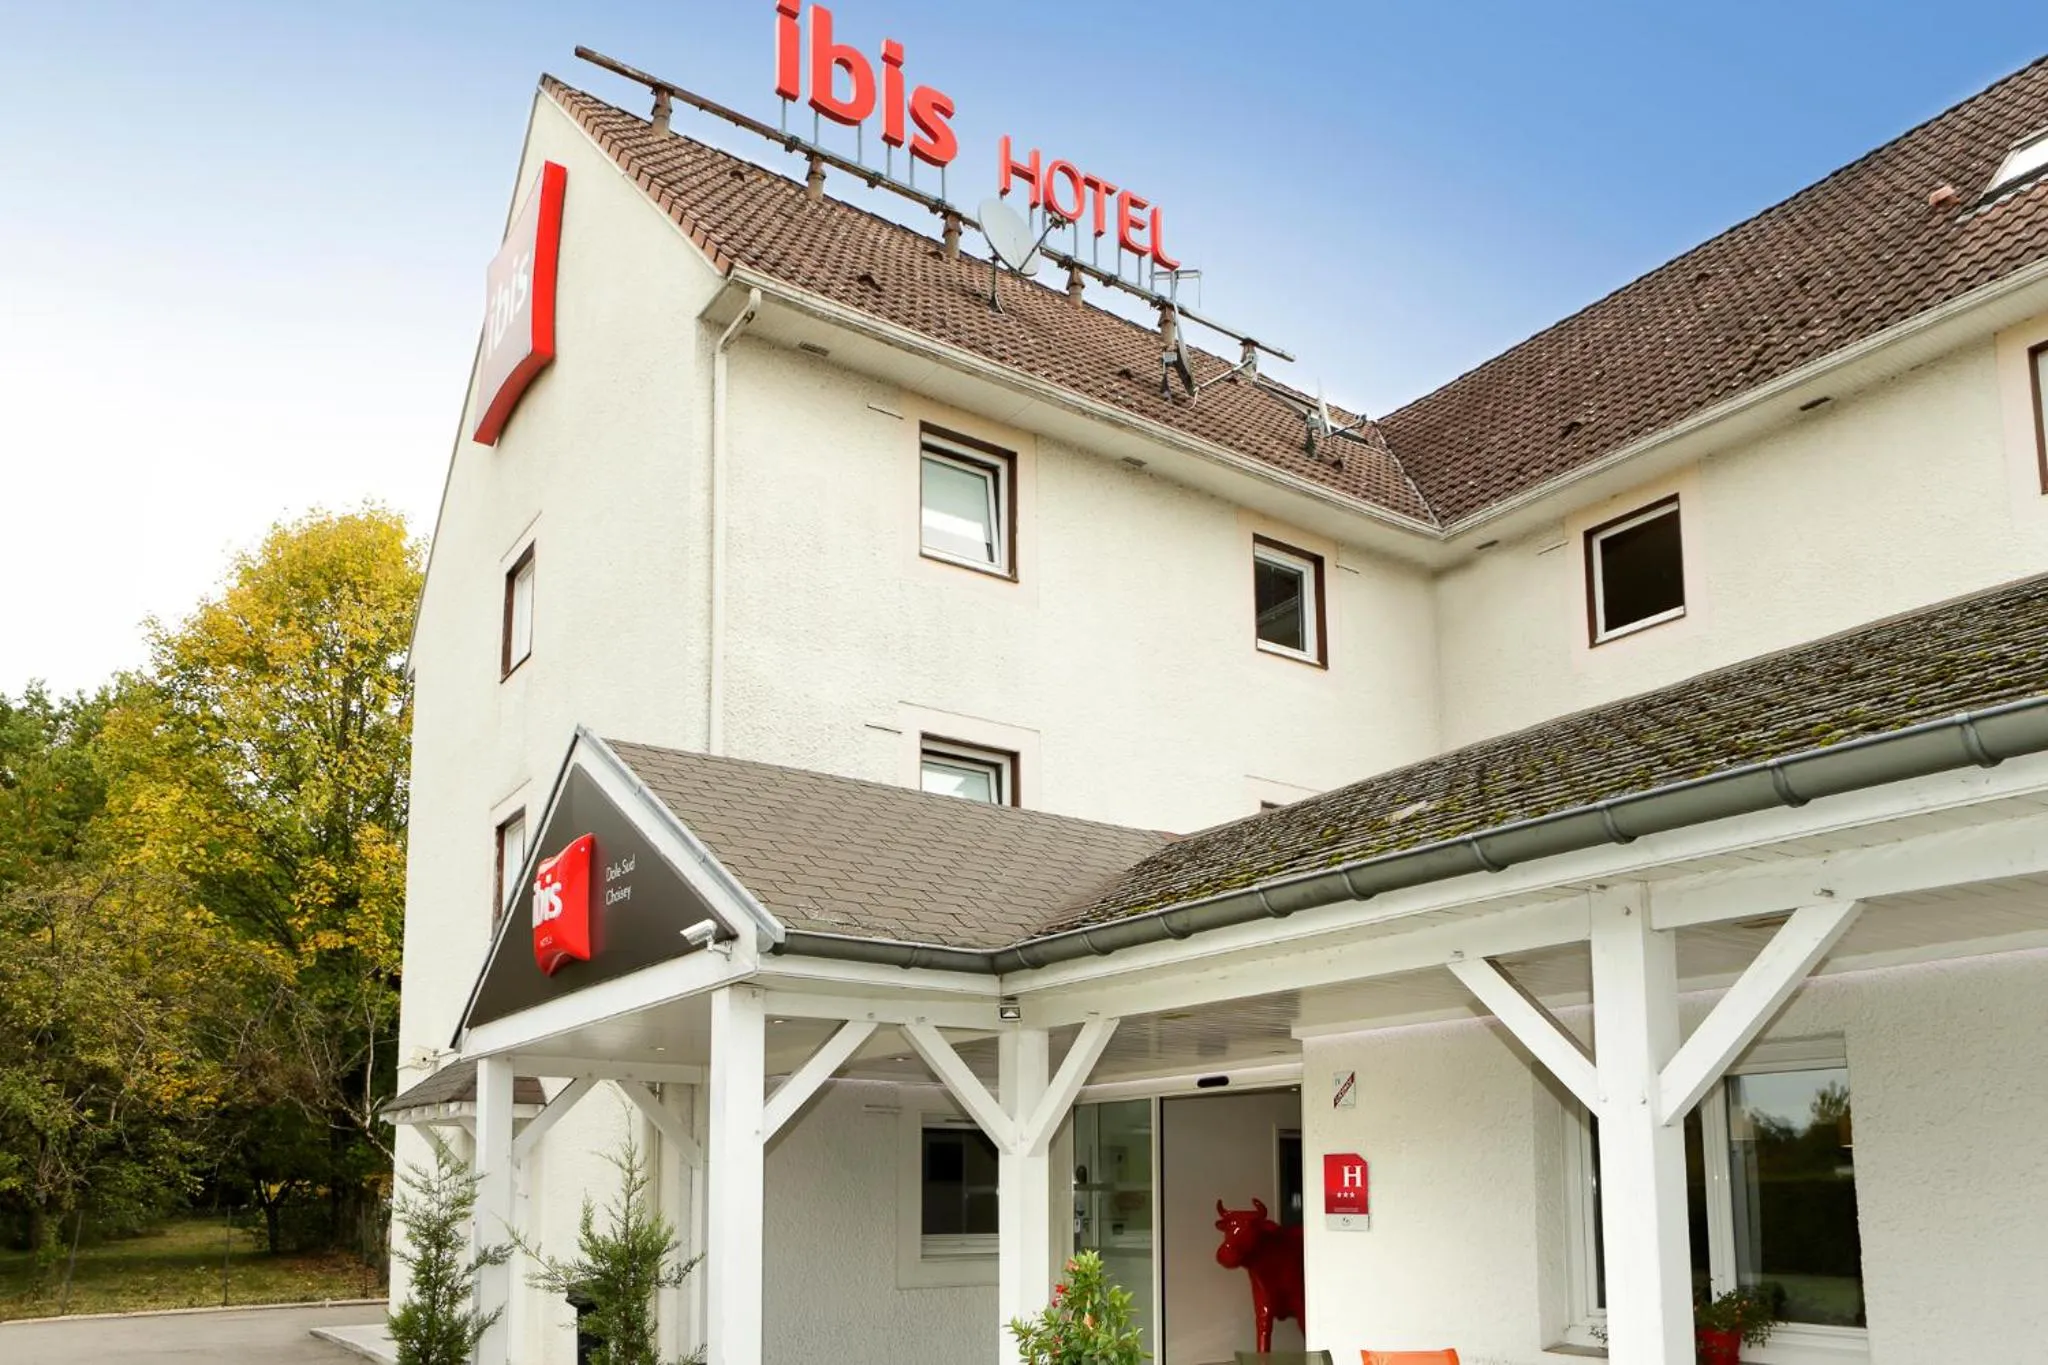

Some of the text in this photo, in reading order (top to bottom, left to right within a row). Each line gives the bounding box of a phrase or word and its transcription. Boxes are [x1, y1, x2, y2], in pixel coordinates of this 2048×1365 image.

[775, 0, 1181, 271] ibis HOTEL
[486, 252, 530, 361] ibis
[622, 853, 636, 875] Sud
[532, 873, 563, 929] bis
[1343, 1165, 1363, 1188] H
